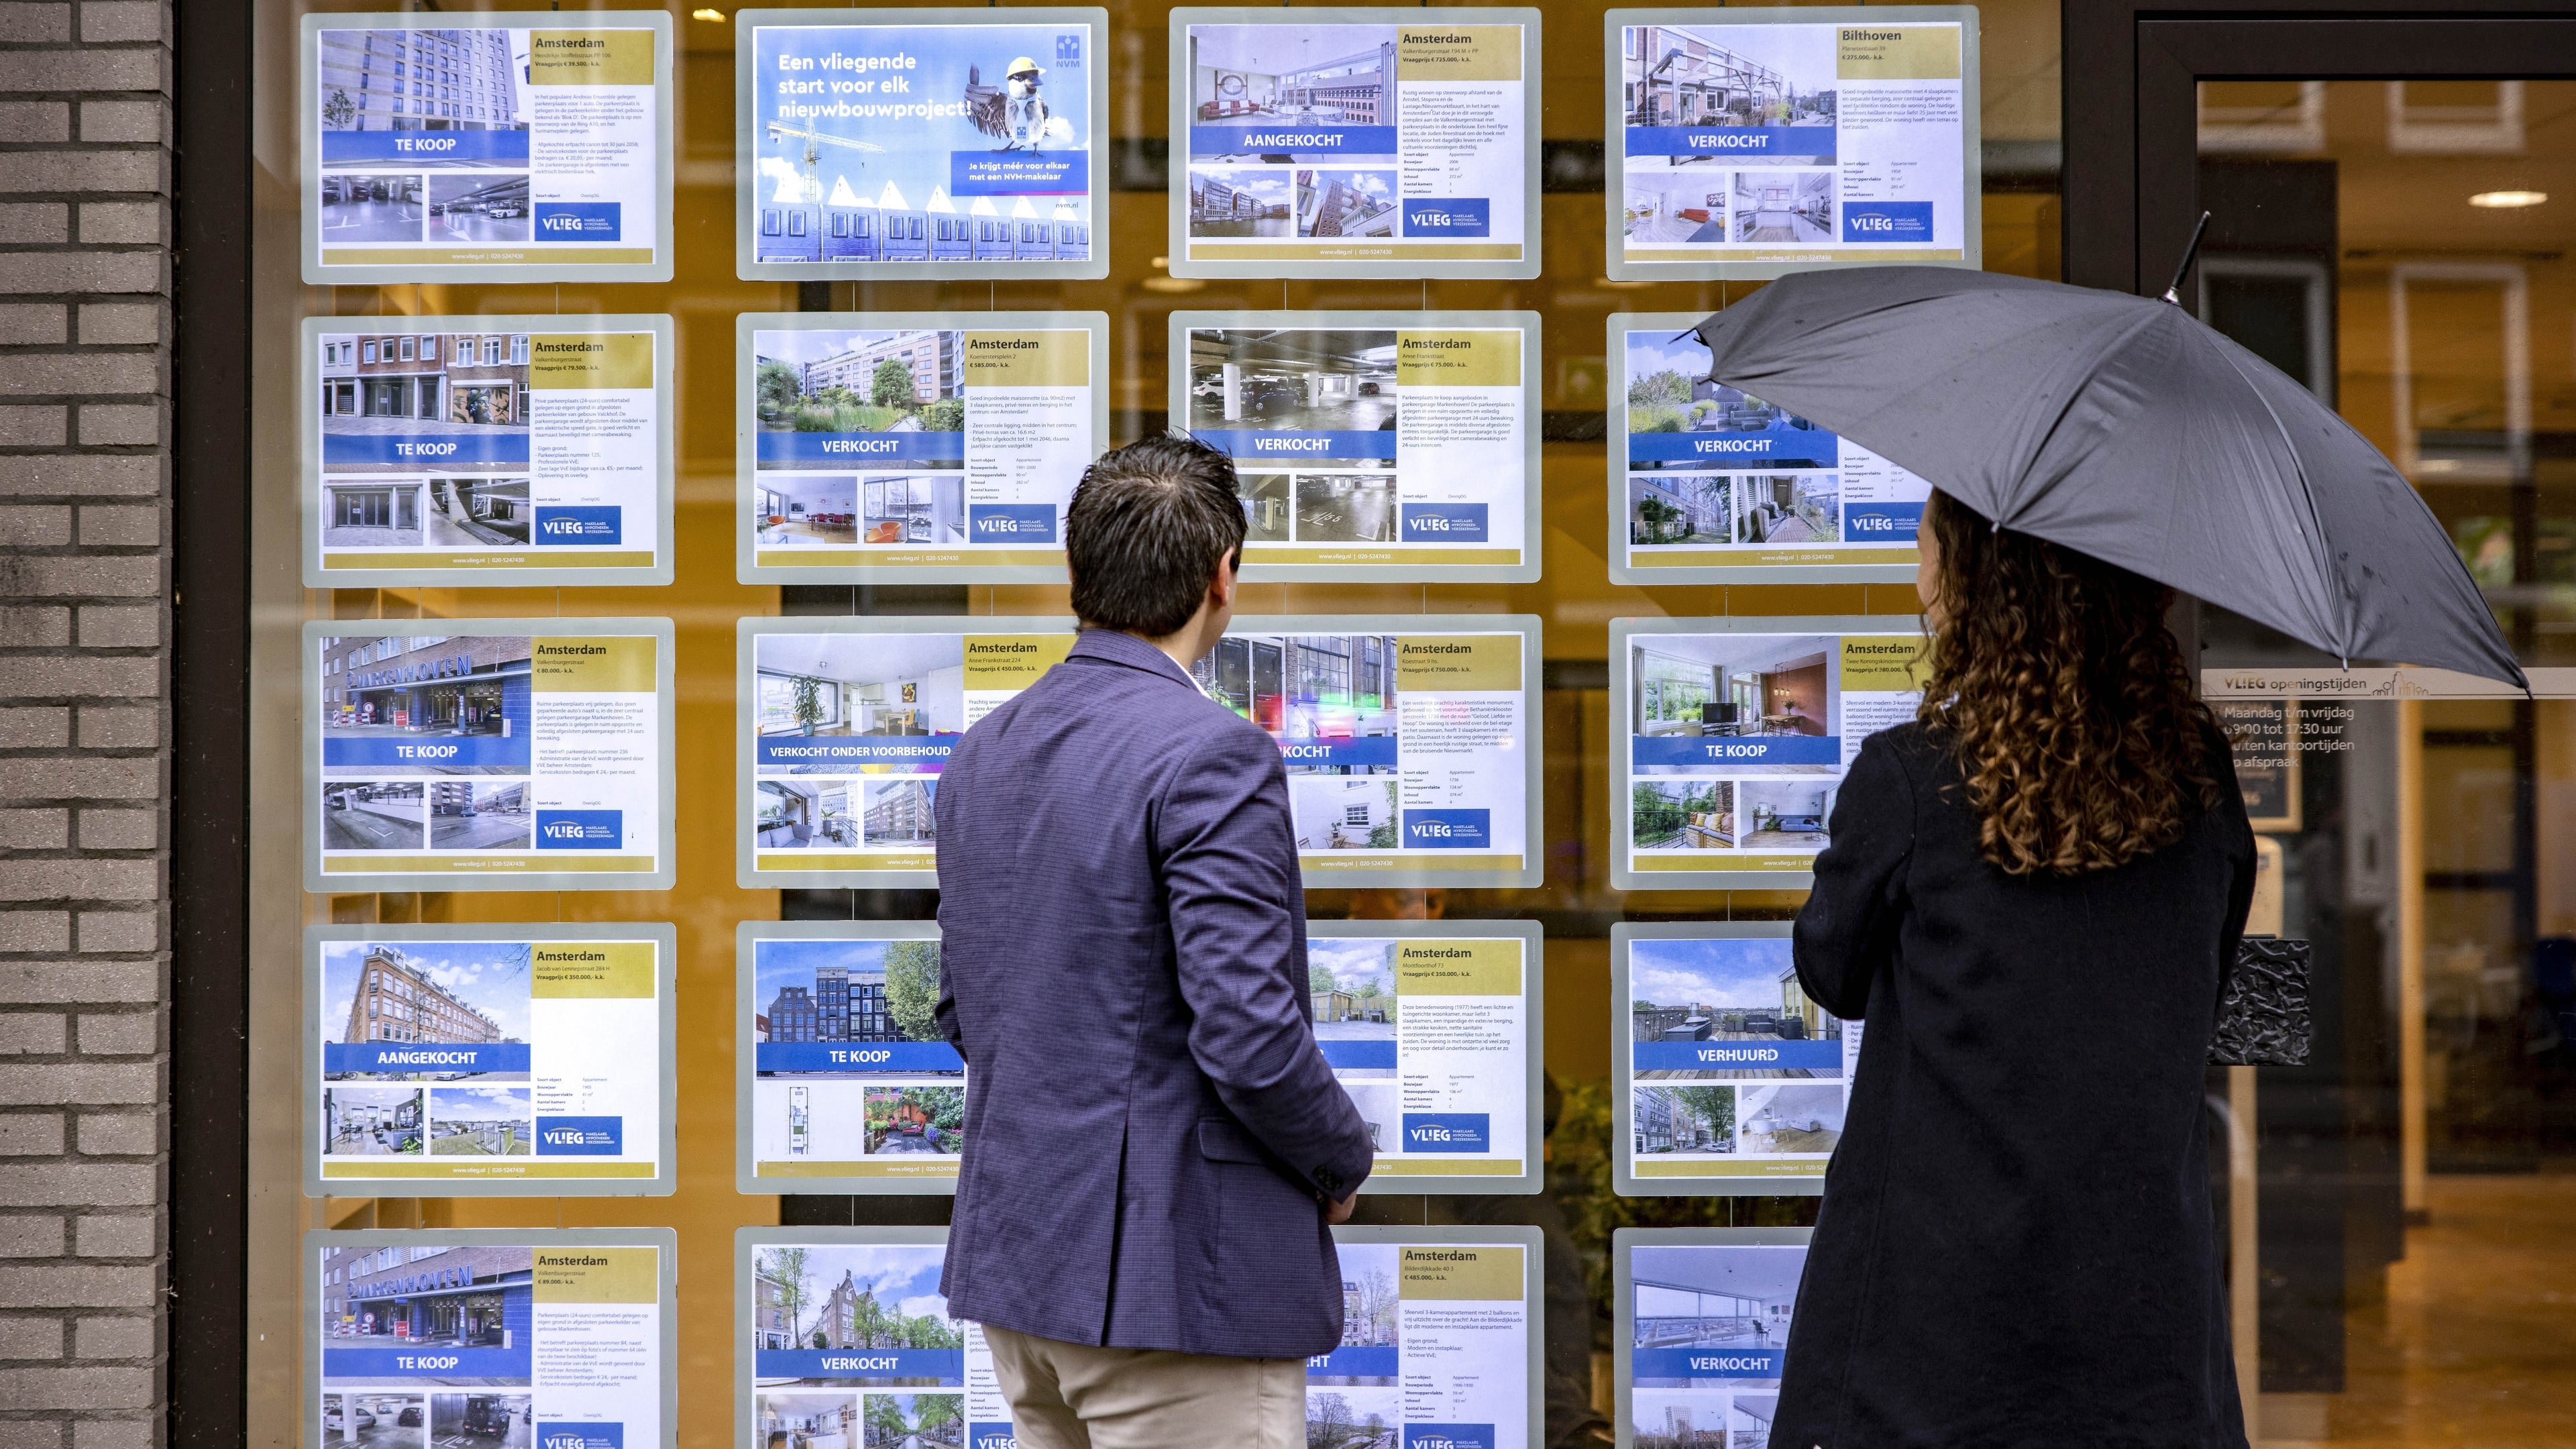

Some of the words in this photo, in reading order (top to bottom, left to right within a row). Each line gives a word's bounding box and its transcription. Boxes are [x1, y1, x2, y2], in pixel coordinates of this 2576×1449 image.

[1403, 34, 1471, 44] Amsterdam
[1843, 30, 1901, 40] Bilthoven
[535, 38, 604, 48] Amsterdam
[779, 54, 813, 70] Een
[819, 52, 916, 73] vliegende
[779, 79, 824, 94] start
[830, 81, 875, 93] voor
[881, 76, 910, 93] elk
[780, 99, 971, 120] nieuwbouwproject!
[395, 139, 412, 150] TE
[416, 139, 456, 150] KOOP
[1244, 134, 1343, 146] AANGEKOCHT
[1688, 136, 1768, 147] VERKOCHT
[979, 162, 1001, 171] krijgt
[1003, 162, 1024, 170] méér
[542, 219, 582, 230] VLIEG
[1411, 214, 1450, 226] VLIEG
[1851, 218, 1892, 230] VLIEG
[535, 341, 603, 352] Amsterdam
[970, 339, 1038, 349] Amsterdam
[1403, 339, 1470, 348] Amsterdam
[396, 443, 413, 455] TE
[417, 443, 457, 455] KOOP
[822, 440, 899, 452] VERKOCHT
[1255, 439, 1331, 450] VERKOCHT
[1695, 440, 1772, 452] VERKOCHT
[543, 522, 582, 533] VLIEG
[977, 520, 1017, 532] VLIEG
[1409, 519, 1449, 531] VLIEG
[1852, 519, 1892, 530] VLIEG
[537, 645, 606, 654] Amsterdam
[969, 643, 1037, 653] Amsterdam
[1403, 643, 1471, 653] Amsterdam
[1846, 643, 1915, 653] Amsterdam
[2225, 678, 2265, 689] VLIEG
[2271, 678, 2366, 692] openingstijden
[2224, 707, 2282, 720] Maandag
[2285, 707, 2308, 718] t/m
[2312, 706, 2354, 720] vrijdag
[2263, 724, 2283, 734] tot
[2287, 724, 2319, 734] 17:30
[2322, 726, 2343, 734] uur
[396, 746, 414, 757] TE
[417, 746, 458, 757] KOOP
[770, 747, 829, 756] VERKOCHT
[831, 747, 870, 756] ONDER
[871, 747, 951, 756] VOORBEHOUD
[1279, 746, 1332, 757] KOCHT
[1706, 745, 1723, 757] TE
[1727, 745, 1767, 757] KOOP
[2269, 739, 2355, 753] kantoortijden
[2245, 756, 2298, 769] afspraak
[544, 826, 583, 838] VLIEG
[1411, 825, 1451, 837] VLIEG
[537, 951, 604, 961] Amsterdam
[1403, 948, 1471, 958] Amsterdam
[378, 1052, 477, 1064] AANGEKOCHT
[829, 1051, 847, 1062] TE
[851, 1051, 891, 1062] KOOP
[1697, 1049, 1778, 1061] VERHUURD
[544, 1132, 584, 1144] VLIEG
[1411, 1130, 1450, 1141] VLIEG
[539, 1255, 608, 1265] Amsterdam
[1405, 1250, 1477, 1260] Amsterdam
[397, 1357, 414, 1368] TE
[418, 1357, 458, 1368] KOOP
[821, 1358, 898, 1369] VERKOCHT
[1690, 1358, 1770, 1370] VERKOCHT
